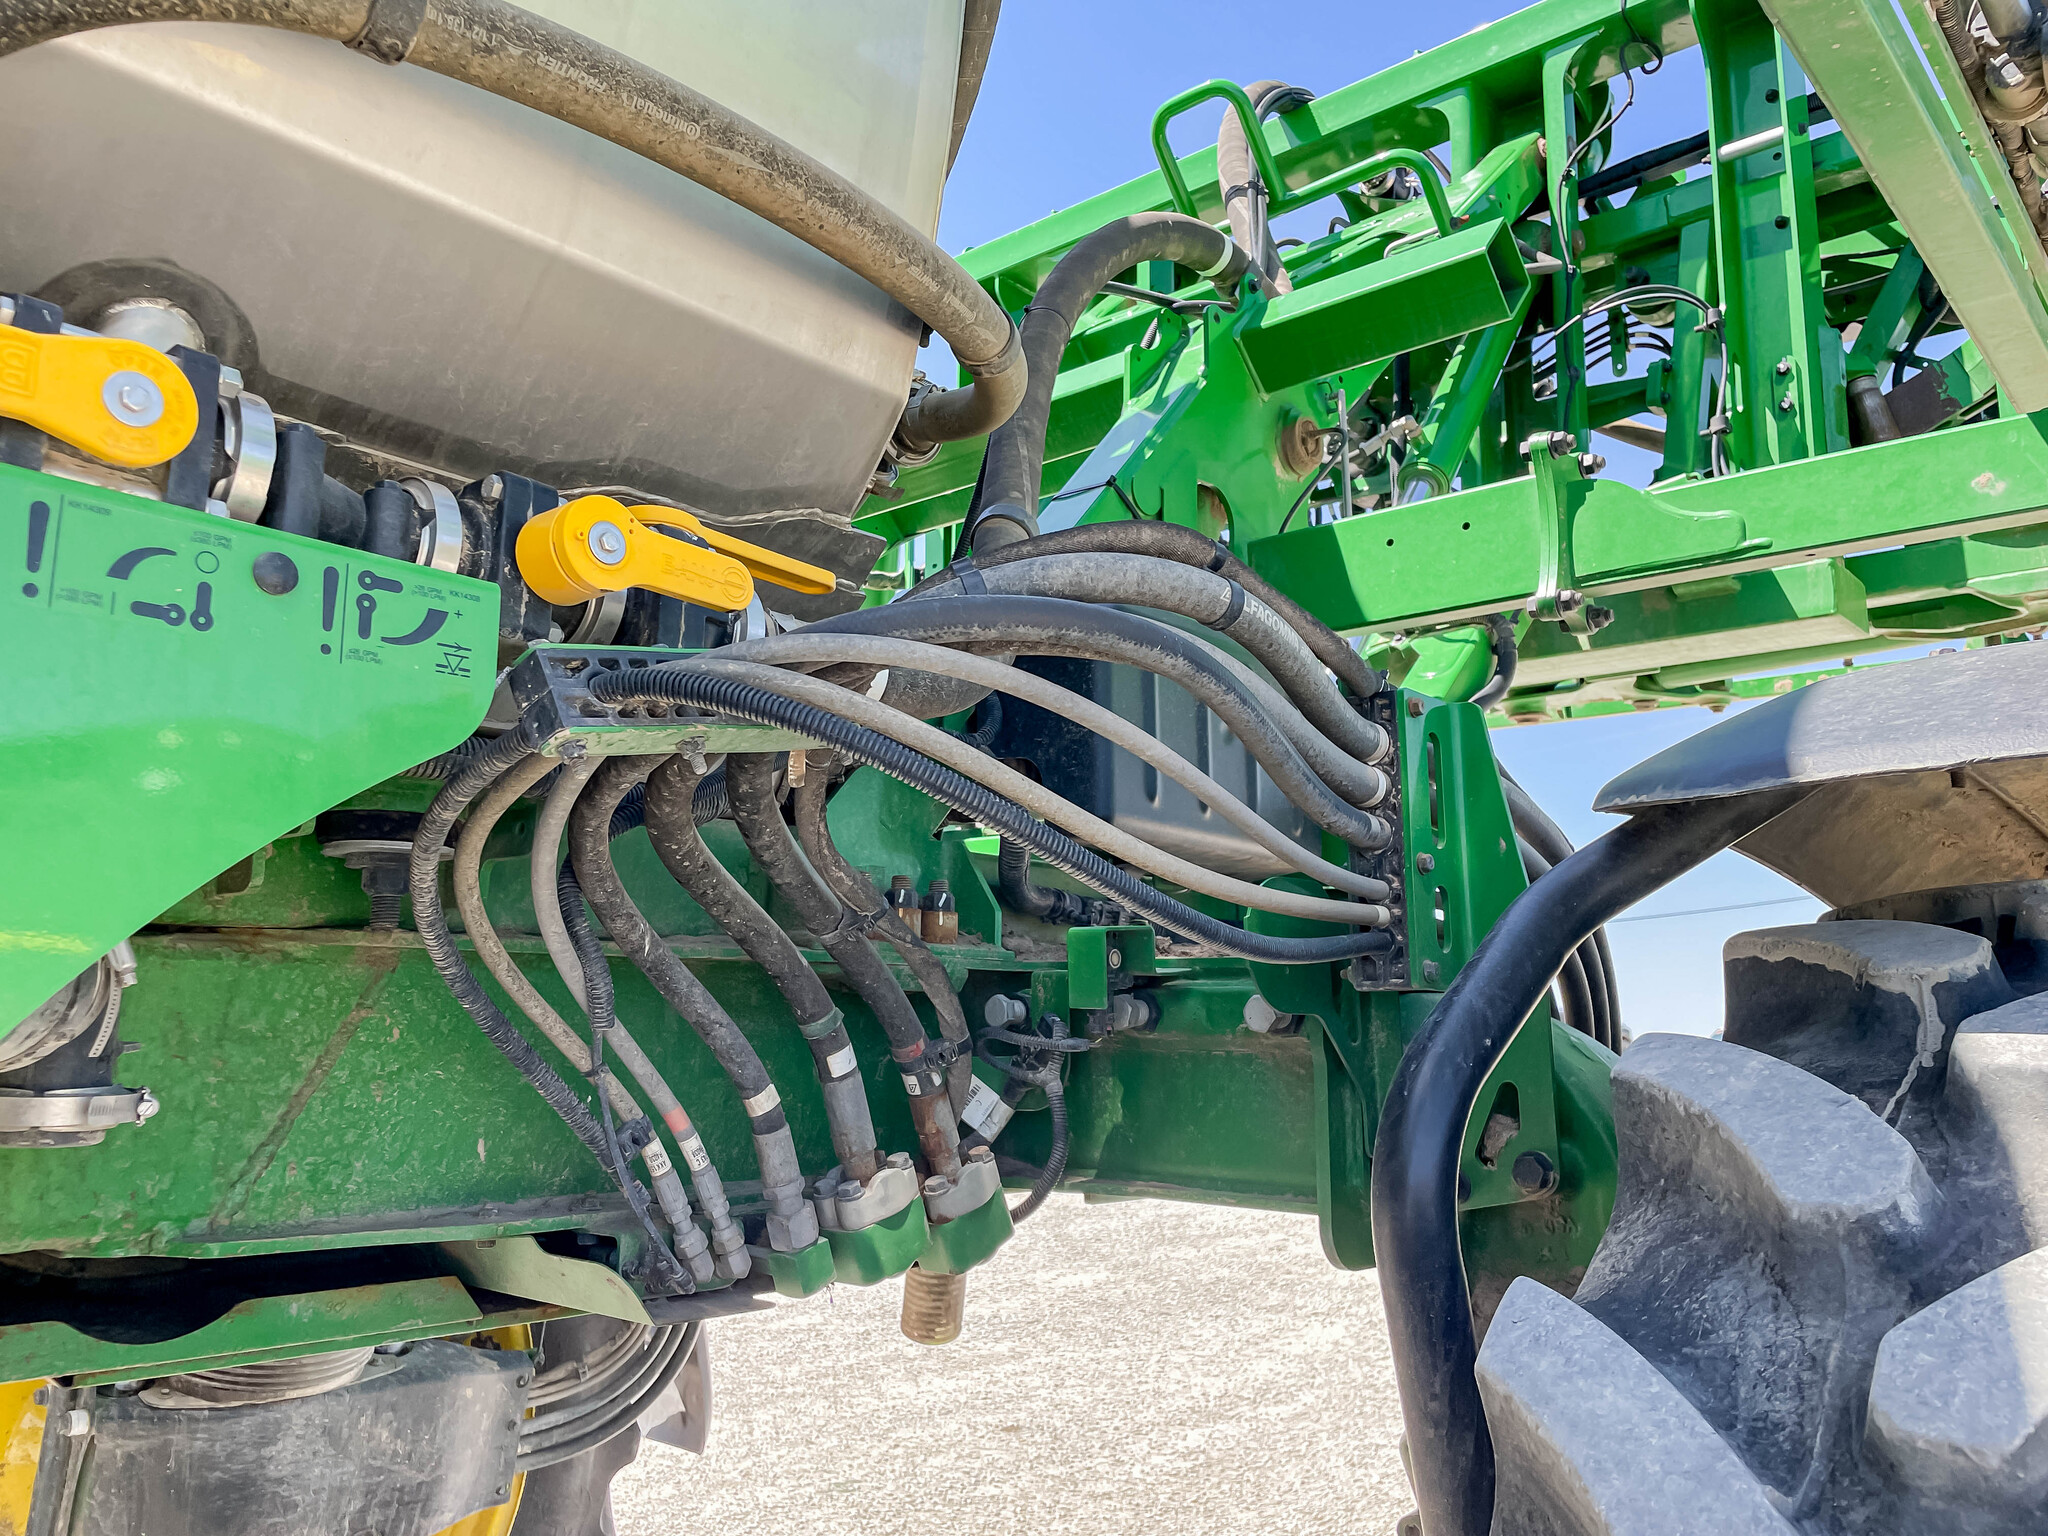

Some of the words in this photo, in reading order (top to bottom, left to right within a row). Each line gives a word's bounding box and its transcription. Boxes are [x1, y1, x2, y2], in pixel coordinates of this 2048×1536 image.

[536, 50, 608, 95] FRONTIER
[632, 94, 701, 140] Continental
[1243, 596, 1300, 652] LFAGOMMA
